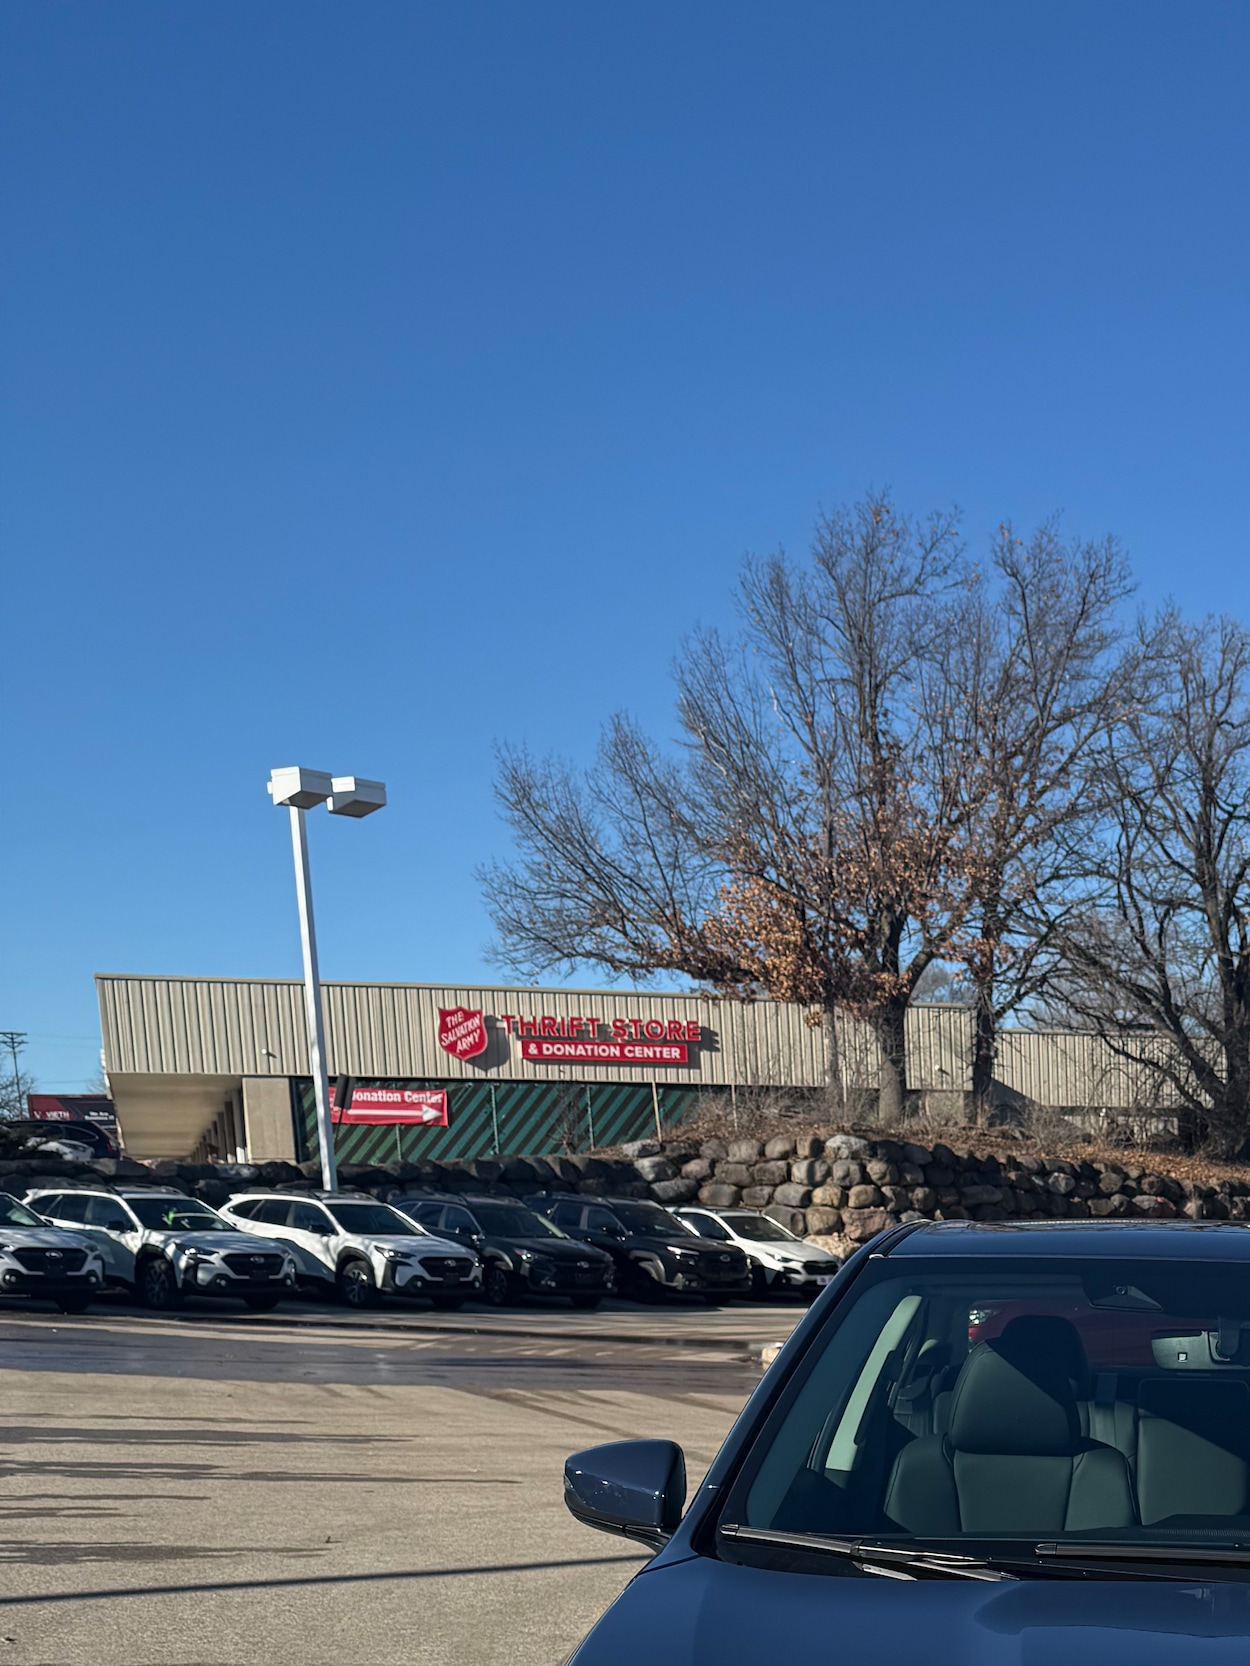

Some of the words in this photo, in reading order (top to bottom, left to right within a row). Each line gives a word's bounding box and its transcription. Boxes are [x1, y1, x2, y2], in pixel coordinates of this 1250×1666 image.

[446, 1011, 464, 1028] THE
[501, 1015, 601, 1038] THRIFT
[611, 1018, 701, 1041] STORE
[441, 1014, 481, 1046] SALVATION
[456, 1029, 480, 1053] ARMY
[528, 1043, 538, 1055] &
[542, 1043, 620, 1057] DONATION
[624, 1046, 680, 1059] CENTER
[404, 1091, 443, 1103] Center
